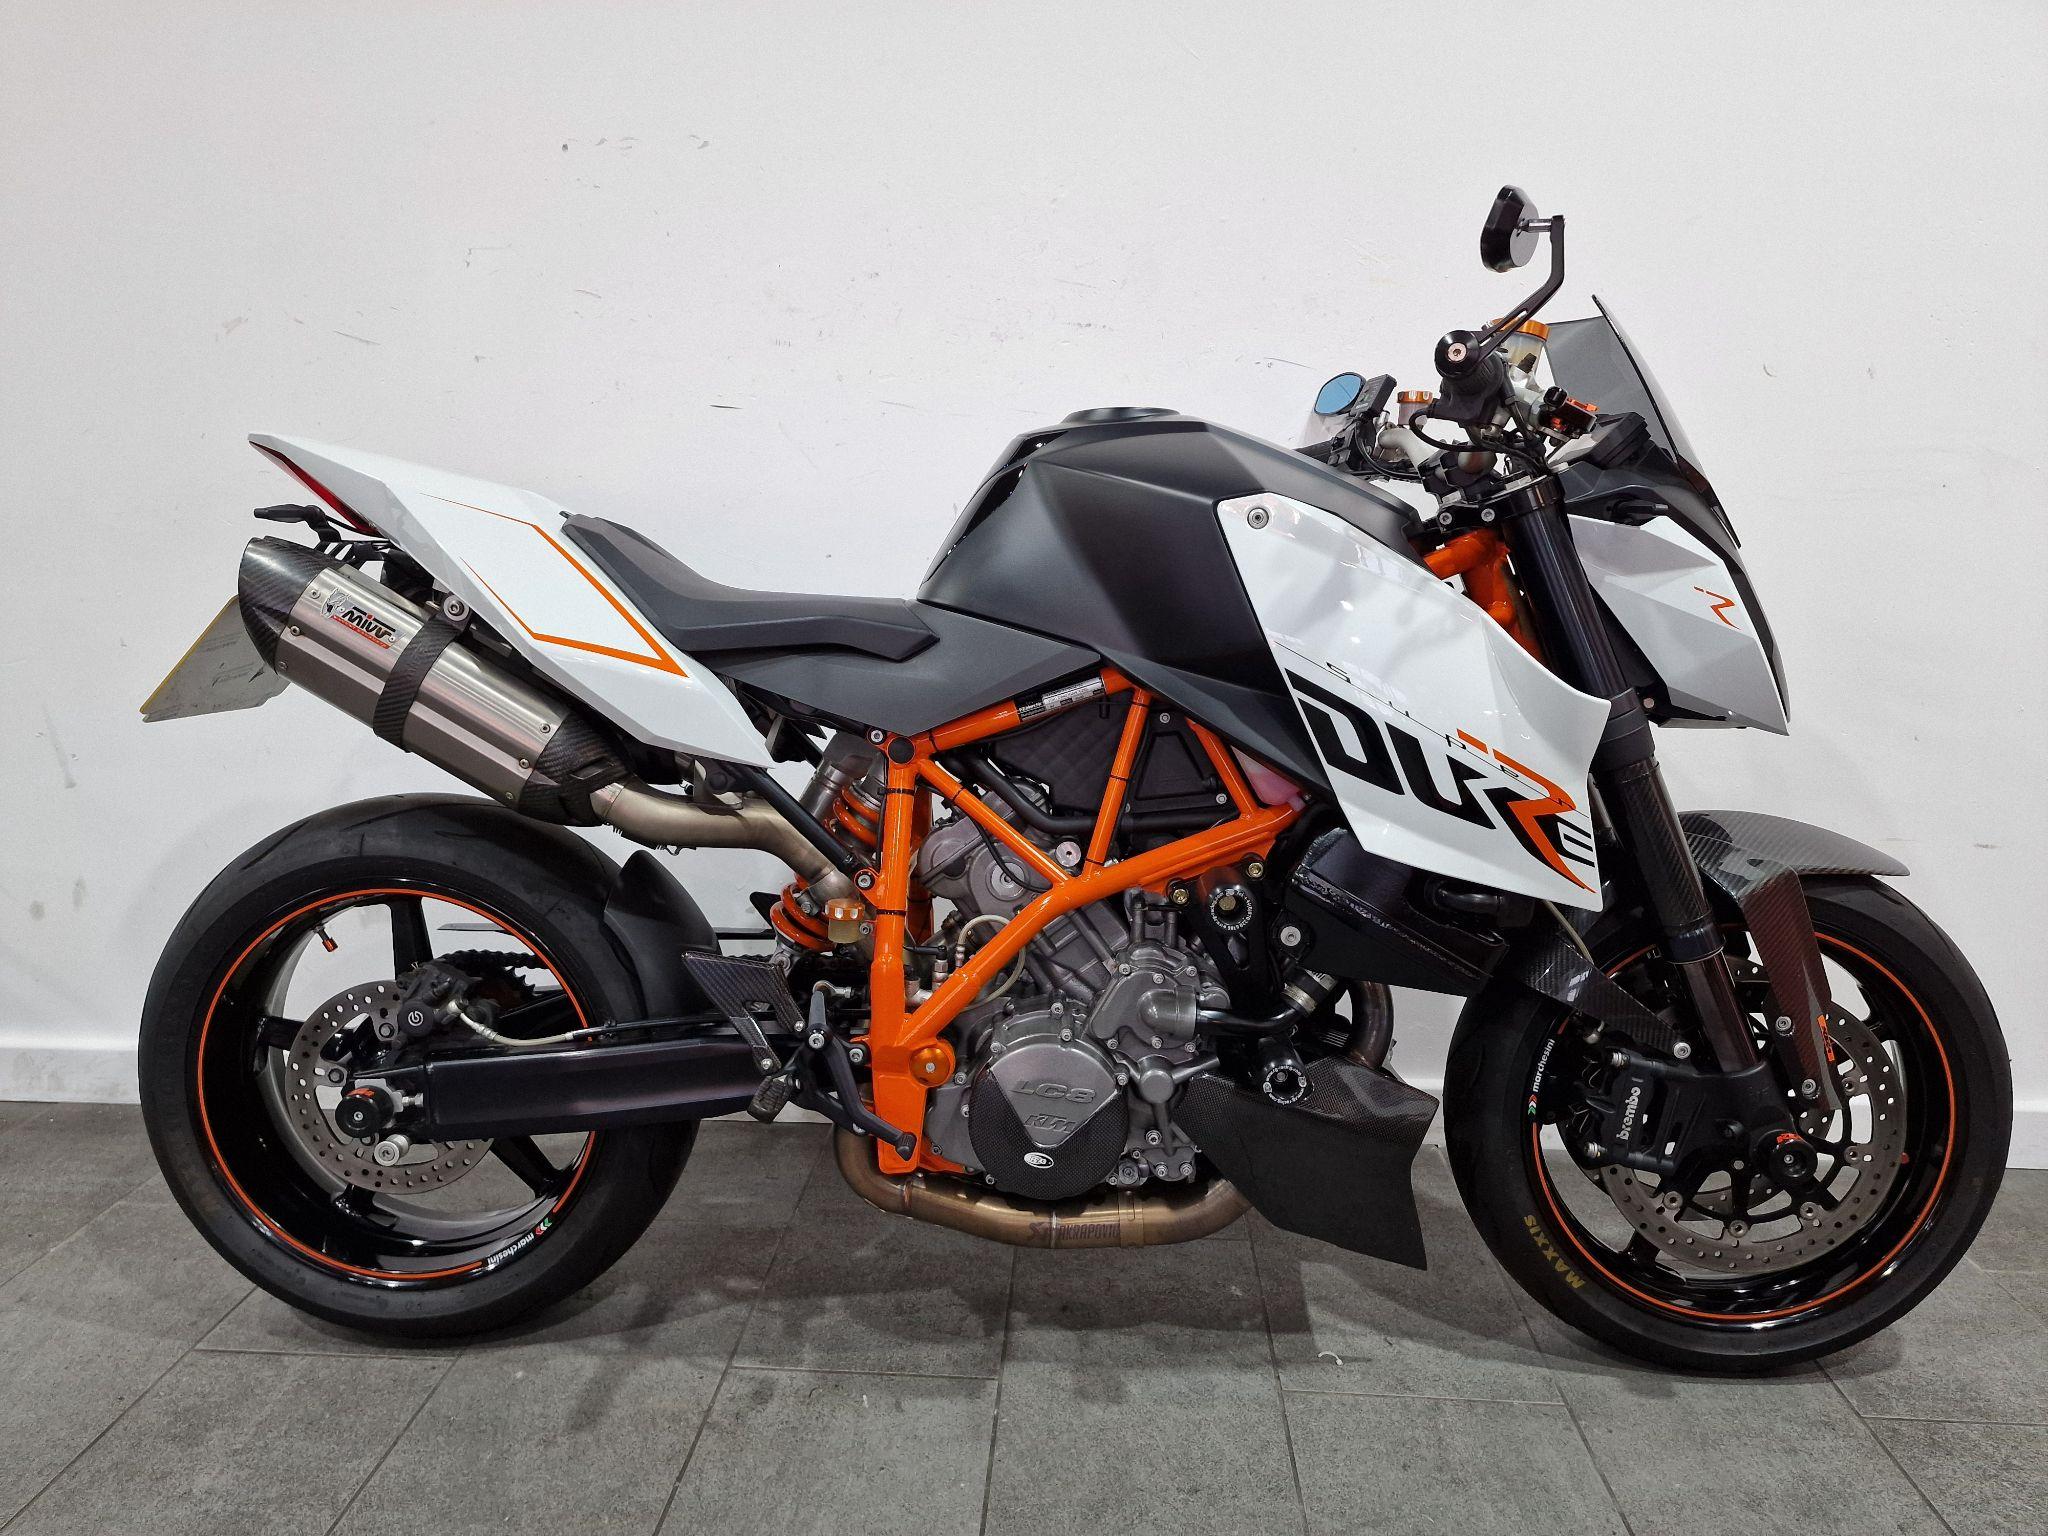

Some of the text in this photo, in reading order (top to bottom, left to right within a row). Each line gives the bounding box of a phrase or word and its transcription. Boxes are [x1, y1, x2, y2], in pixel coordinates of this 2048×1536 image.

[1532, 1038, 1556, 1093] marchesini
[1008, 1081, 1097, 1105] LC8
[1615, 1085, 1641, 1141] brembo
[1023, 1113, 1077, 1134] KTM
[486, 1231, 535, 1265] marchesini
[1523, 1214, 1586, 1289] MAXXIS
